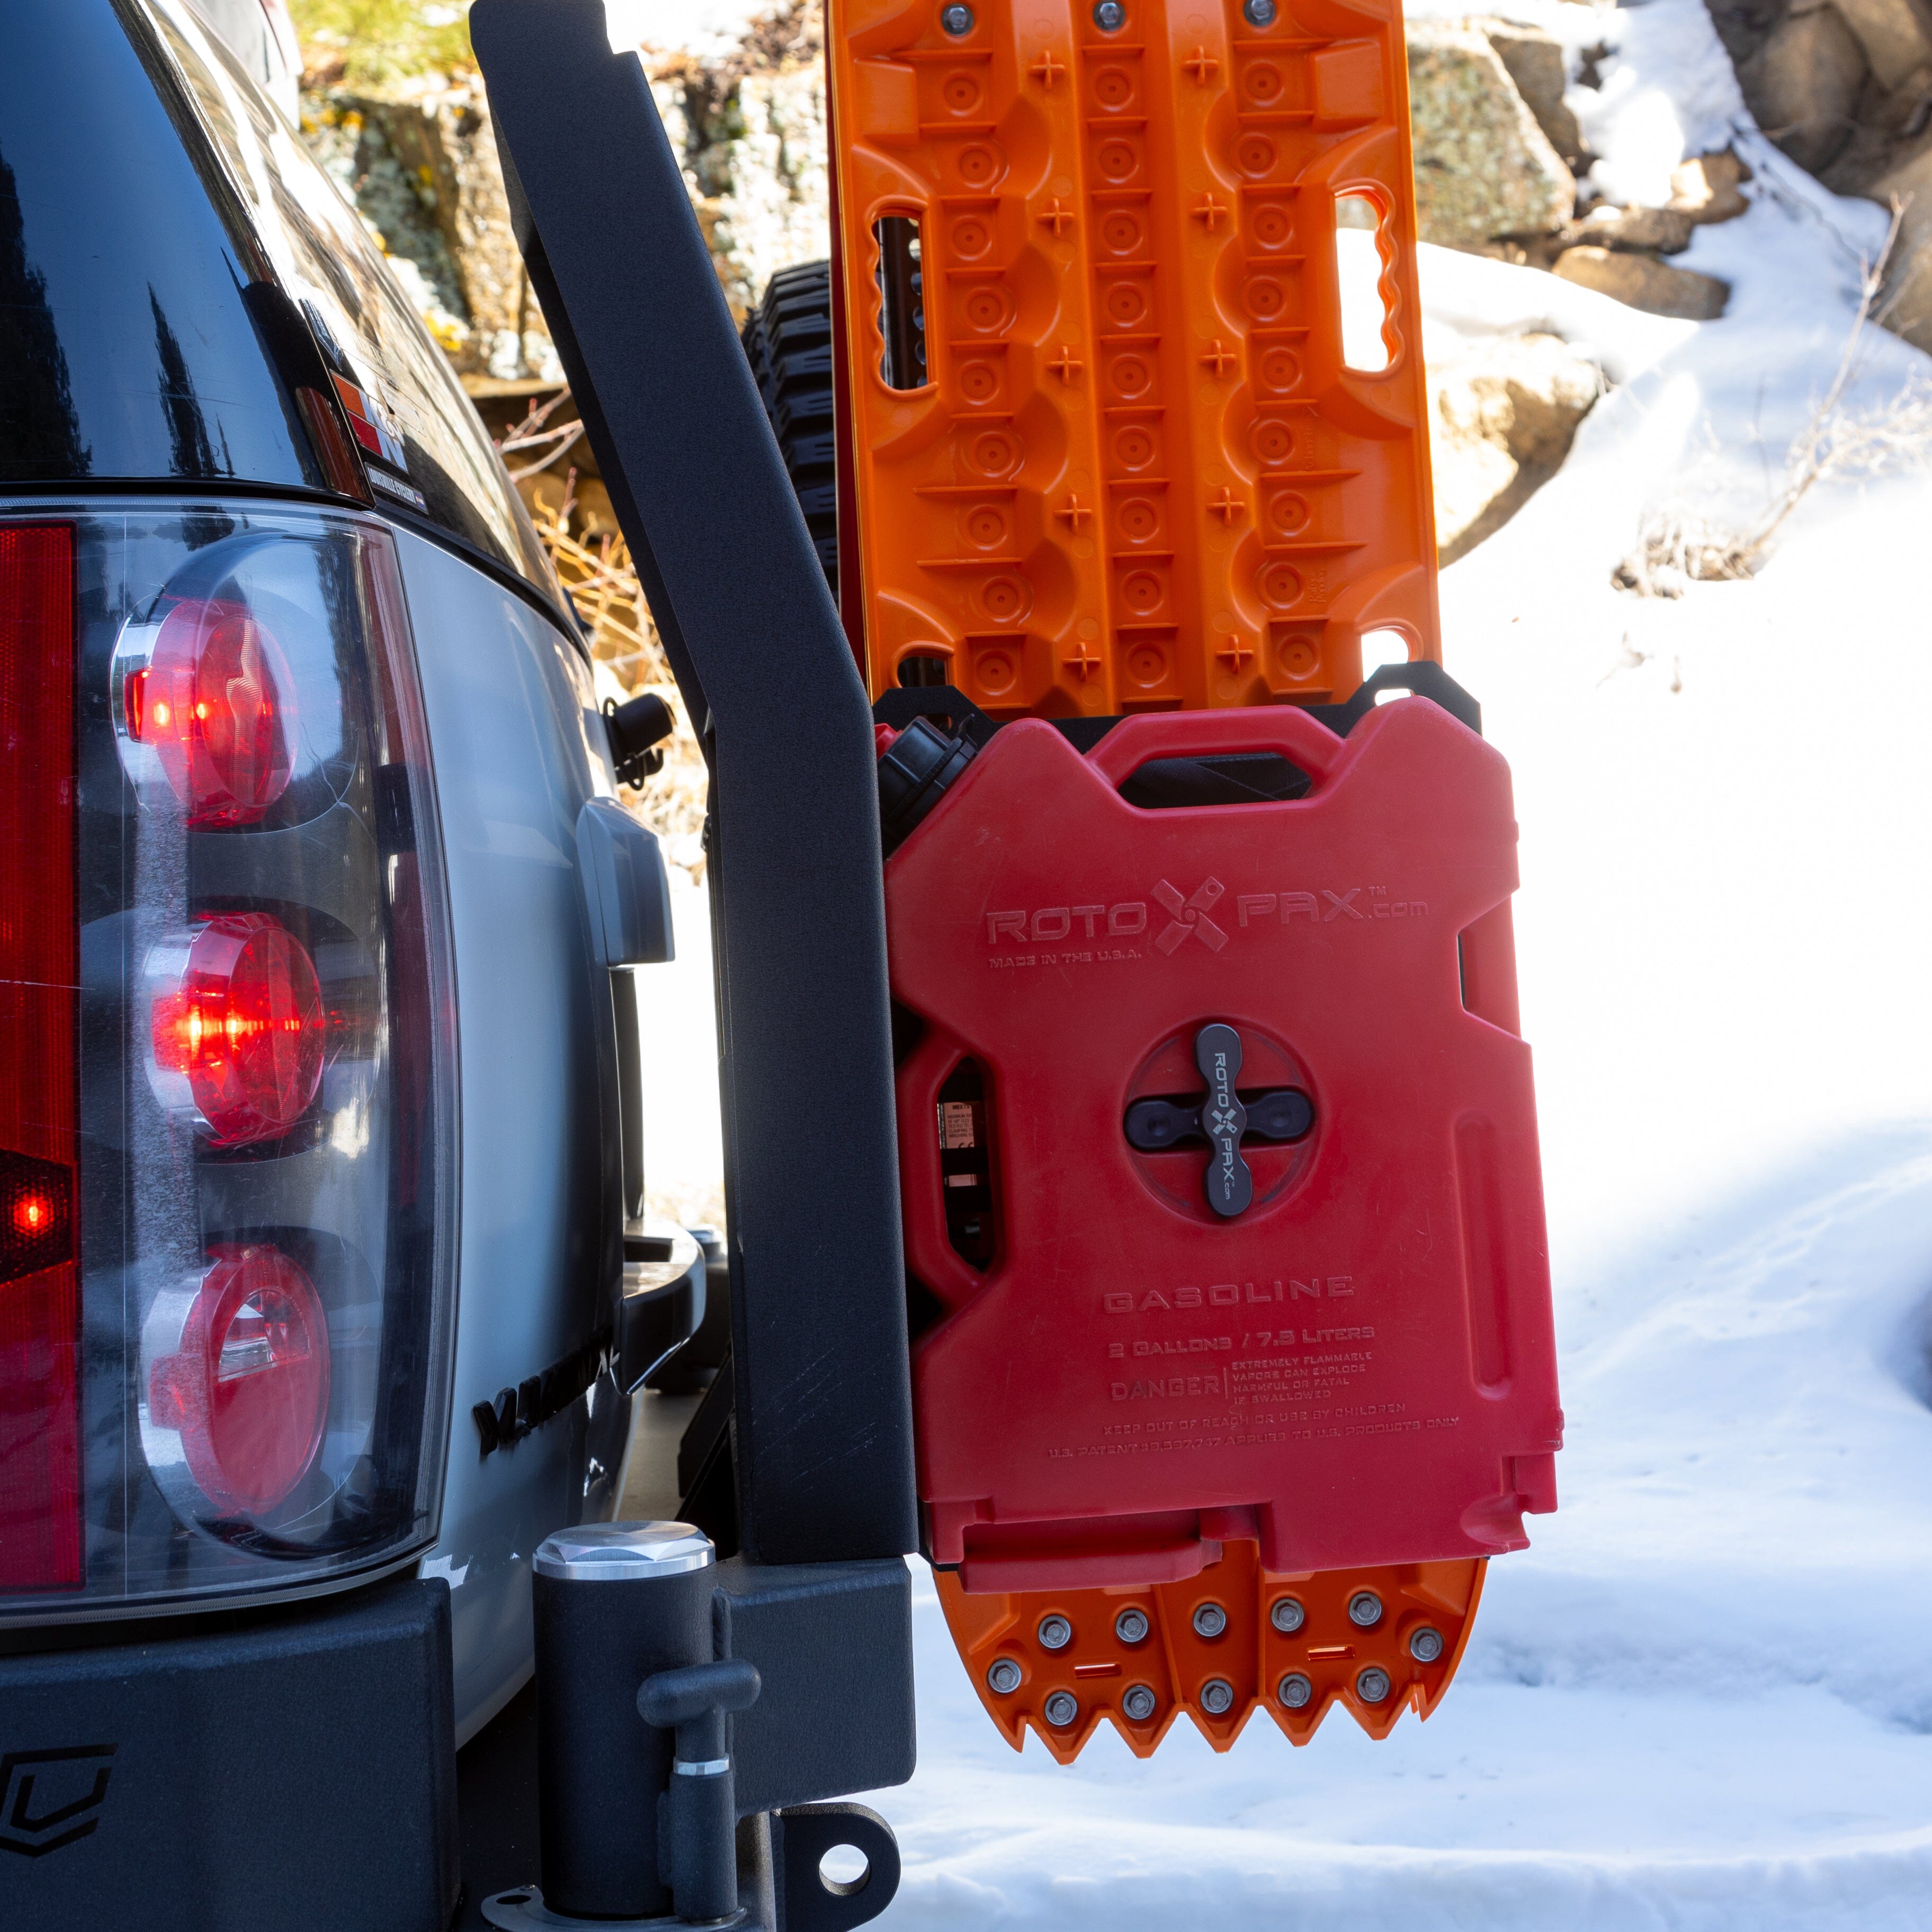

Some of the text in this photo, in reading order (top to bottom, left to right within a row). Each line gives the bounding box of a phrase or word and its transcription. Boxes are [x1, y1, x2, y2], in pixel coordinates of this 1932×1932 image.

[367, 467, 416, 504] LOUISVILLE CYCLERY
[986, 902, 1147, 944] ROTO
[989, 949, 1142, 969] MADE IN THE U.S.A.
[1214, 1052, 1229, 1108] ROTO
[1103, 1276, 1354, 1313] GASOLINE
[1108, 1343, 1124, 1358] 2
[1132, 1337, 1232, 1356] GALLONS
[1302, 1326, 1375, 1344] LITERS
[1231, 1352, 1373, 1371] EXTREMELY FLAMMABLE
[1232, 1363, 1366, 1381] VAPORS CAN EXPLODE
[1111, 1376, 1219, 1401] DANGER
[1233, 1377, 1349, 1393] HARMFUL OR FATAL
[1251, 1389, 1331, 1403] SWALLOWED
[1104, 1402, 1406, 1436] KEEP OUT OF REACH OR USE BY CHILDREN
[1049, 1448, 1074, 1459] U.S.
[1077, 1443, 1138, 1457] PATENT
[1224, 1432, 1286, 1446] APPLIES
[1292, 1430, 1311, 1440] TO
[1317, 1427, 1341, 1437] U.S.
[1345, 1420, 1420, 1436] PRODUCTS
[1426, 1416, 1460, 1429] ONLY
